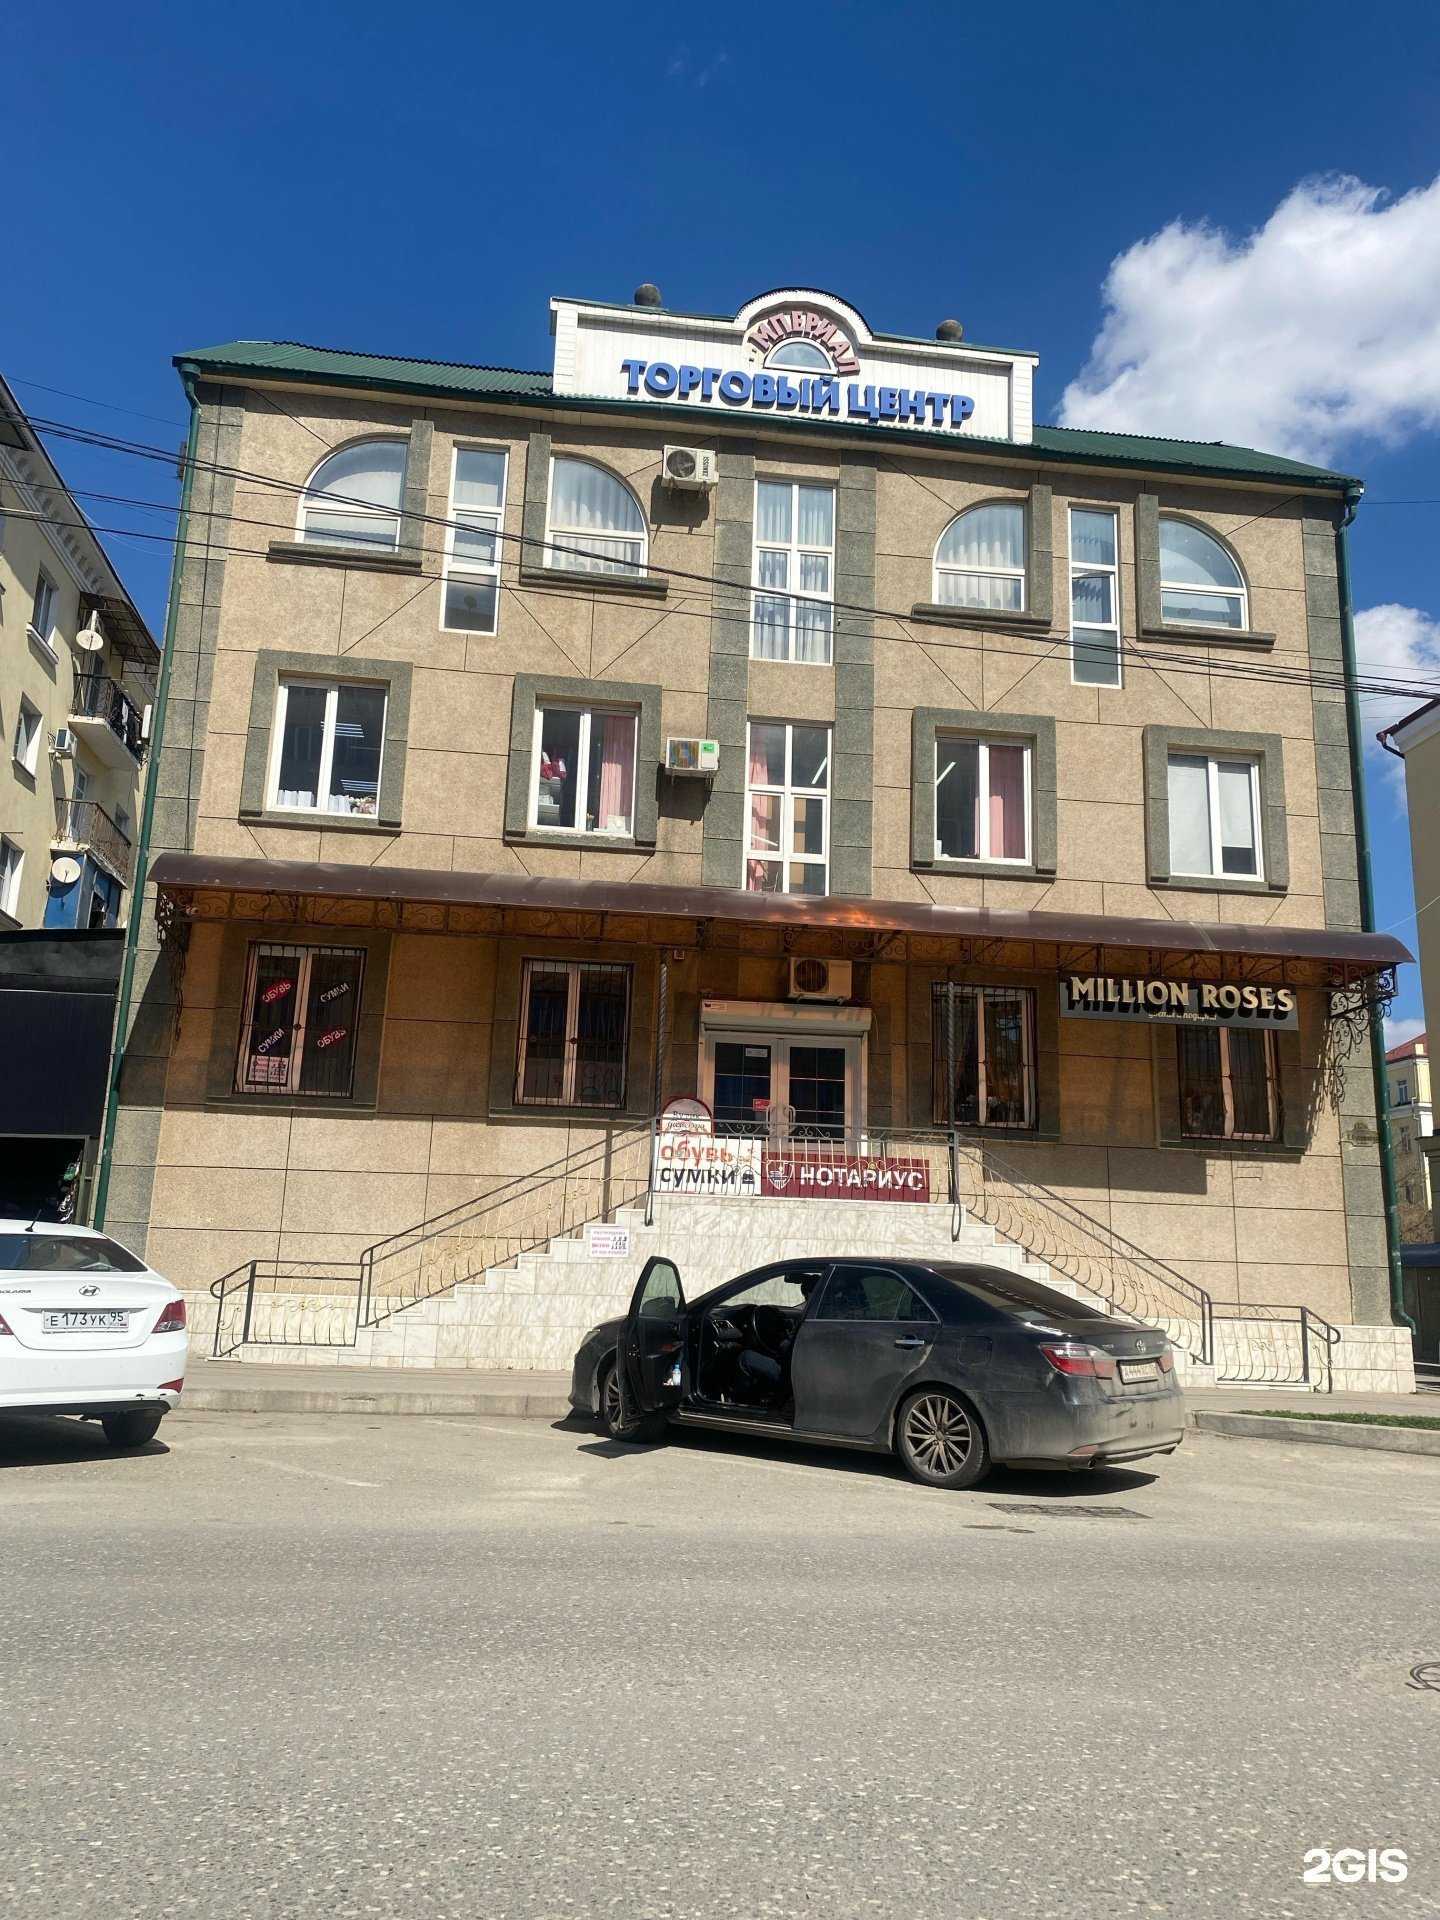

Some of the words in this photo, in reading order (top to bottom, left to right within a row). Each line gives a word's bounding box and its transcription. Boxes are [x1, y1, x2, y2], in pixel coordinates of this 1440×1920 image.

[622, 358, 840, 411] ТОРГОВЫЙ
[847, 383, 975, 427] ЦЕНТР
[1070, 976, 1190, 1006] MILLION
[1201, 984, 1295, 1012] ROSES
[800, 1166, 924, 1191] НОТАРИУС
